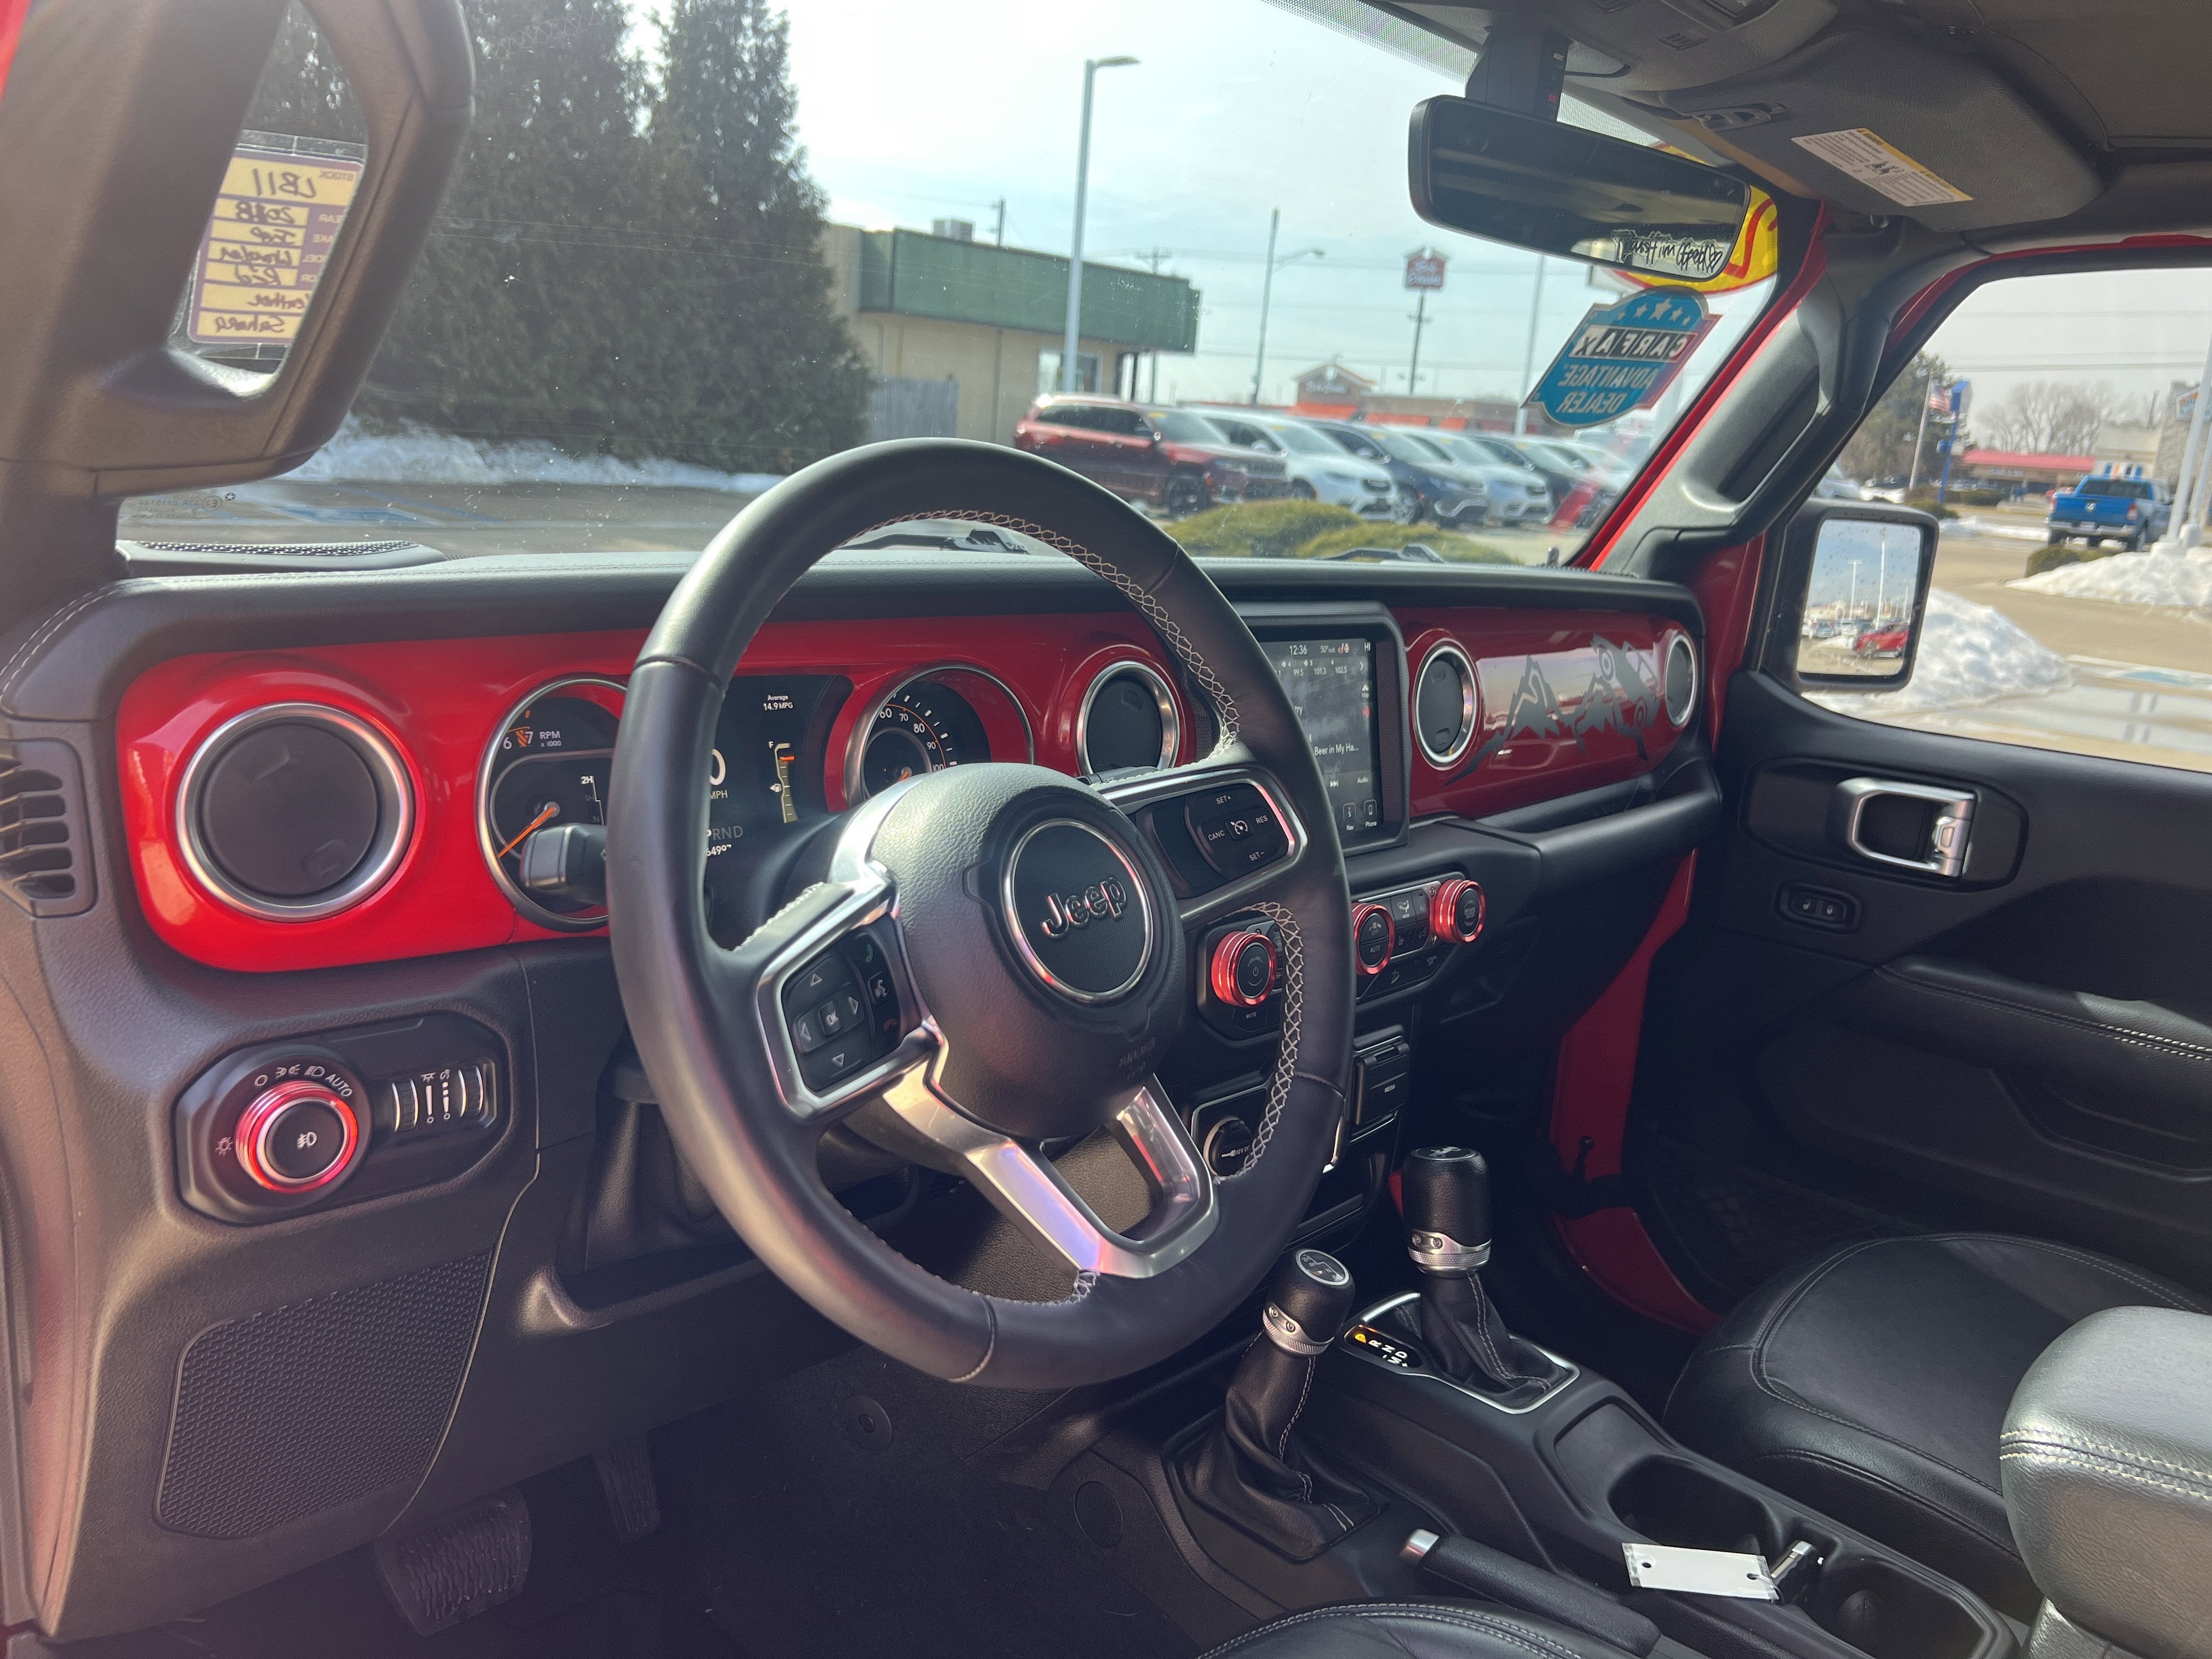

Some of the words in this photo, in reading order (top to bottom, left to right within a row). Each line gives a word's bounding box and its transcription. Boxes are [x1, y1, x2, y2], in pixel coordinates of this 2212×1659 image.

[1289, 644, 1307, 655] 12:36
[1364, 642, 1370, 652] HI
[1293, 668, 1304, 676] 99.5
[1313, 667, 1327, 675] 101.3
[1335, 666, 1347, 674] 102.5
[763, 703, 778, 711] 14.9
[880, 708, 892, 719] 60
[899, 713, 909, 722] 70
[913, 723, 926, 733] 80
[503, 736, 512, 749] 6
[525, 731, 534, 744] 7
[539, 731, 561, 740] RPM
[769, 741, 774, 749] F
[927, 741, 936, 750] 90
[1314, 746, 1328, 756] Beer
[1329, 744, 1334, 754] in
[1335, 743, 1344, 755] My
[933, 764, 944, 772] 100
[580, 775, 594, 785] 2H
[710, 790, 728, 799] MPH
[1255, 815, 1268, 825] RES
[1208, 830, 1225, 841] CANC
[1041, 877, 1127, 939] Jeep
[324, 1073, 353, 1097] AUTO
[1381, 1345, 1395, 1353] N
[1395, 1351, 1408, 1359] D
